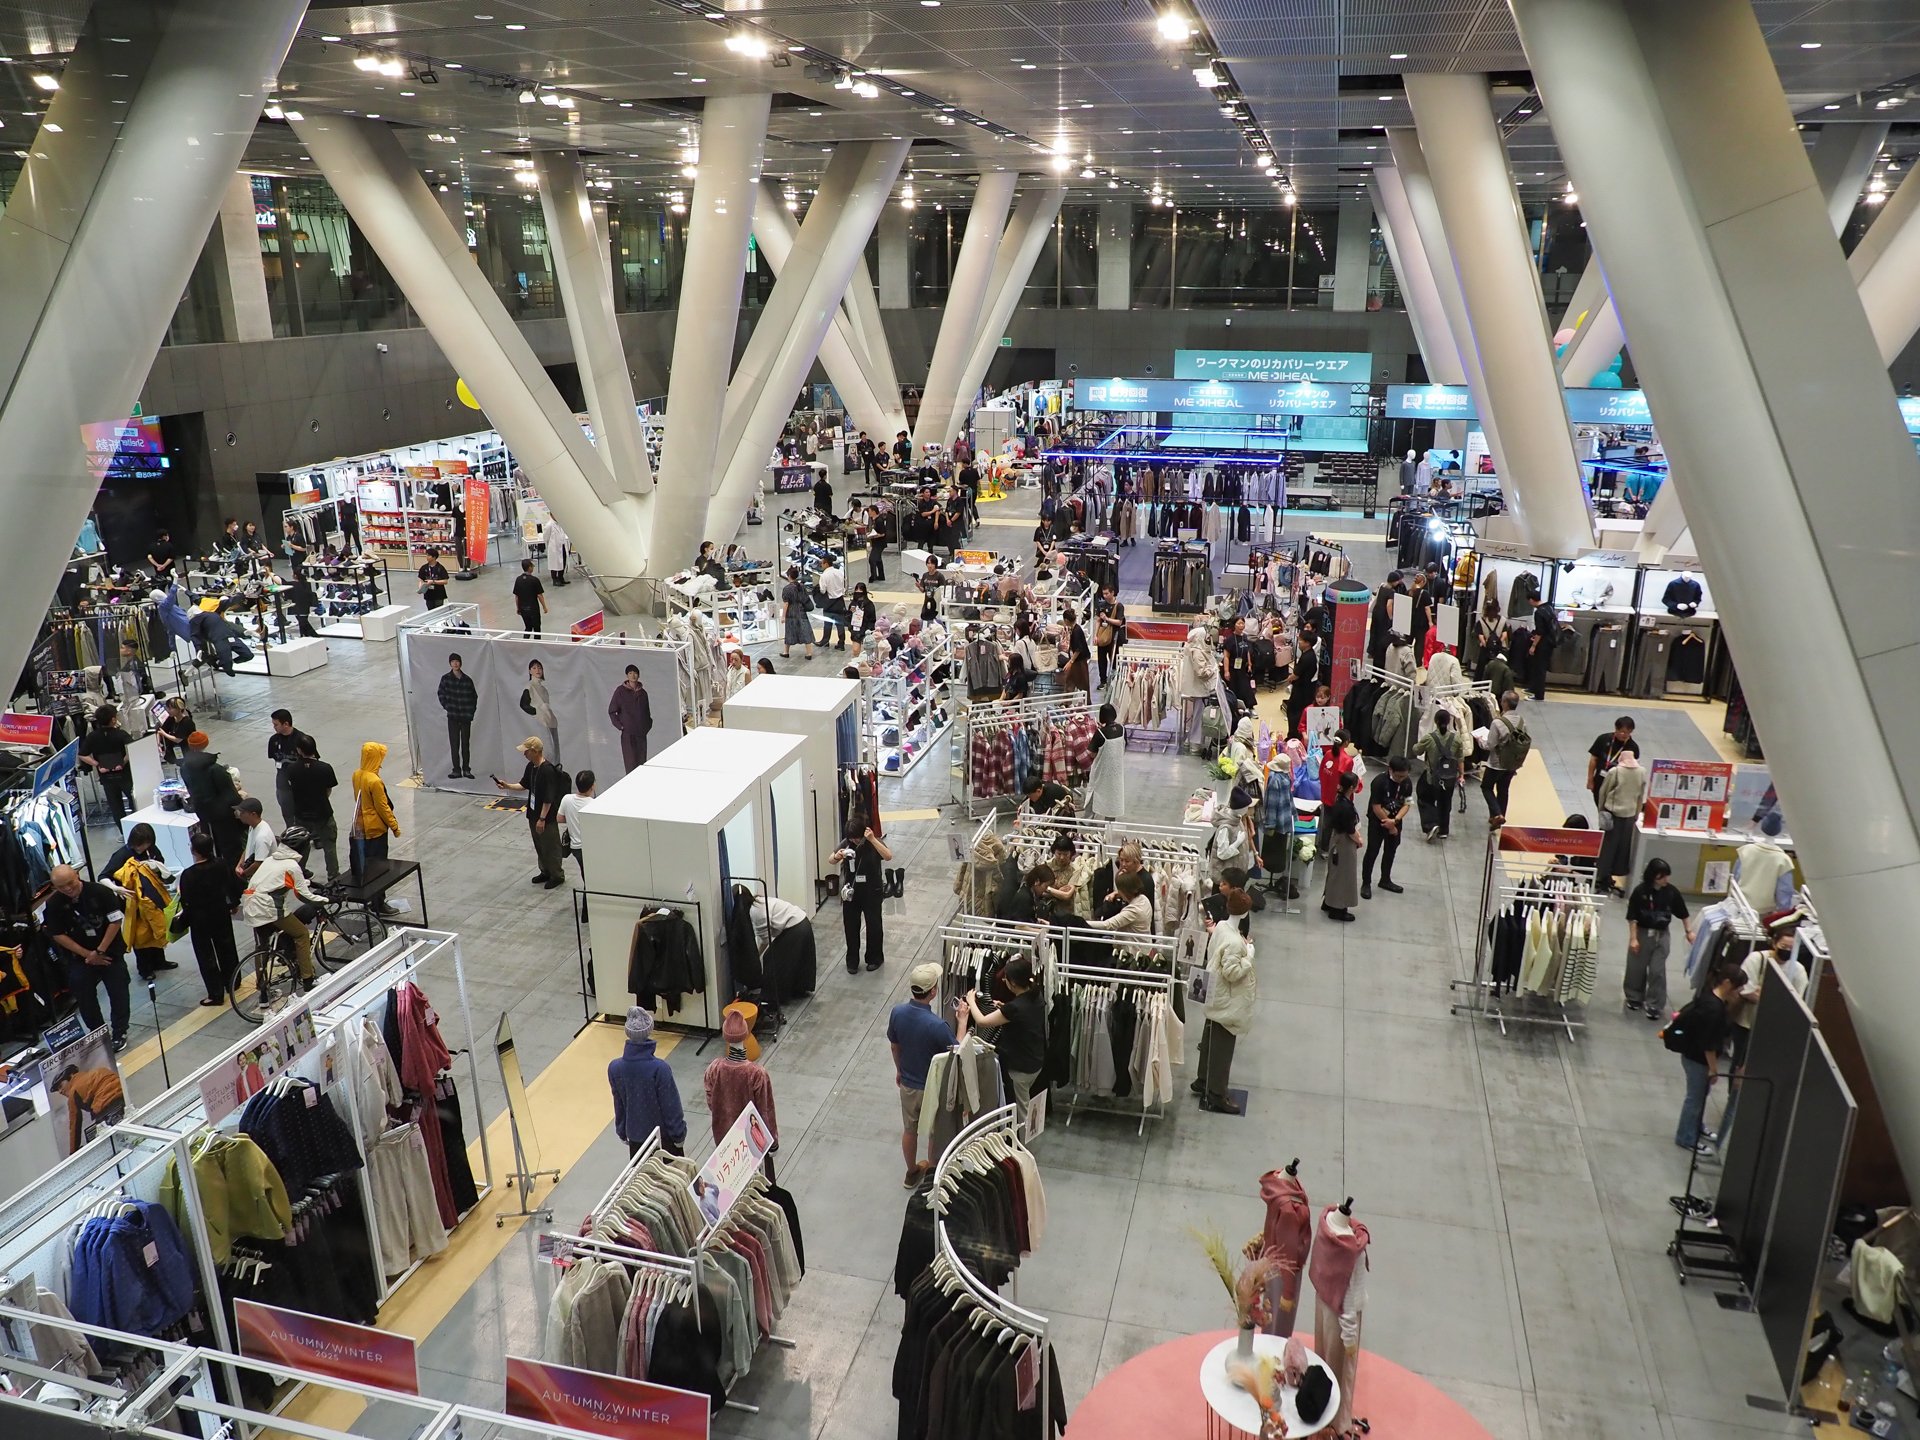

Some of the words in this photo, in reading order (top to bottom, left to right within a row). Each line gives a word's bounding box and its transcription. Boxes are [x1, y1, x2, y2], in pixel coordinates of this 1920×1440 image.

[1196, 357, 1349, 371] ワークマンのリカバリーウエア
[1277, 389, 1330, 399] ワークマンの
[1269, 399, 1337, 409] リカバリーウエア
[1519, 836, 1583, 844] AUTUMN/WINTER
[42, 1041, 85, 1070] CIRCULATOR
[85, 1026, 108, 1045] SERIES
[206, 1090, 235, 1112] WINTER
[207, 1081, 236, 1104] AUTUMN
[716, 1139, 748, 1183] リラックス
[270, 1329, 384, 1363] AUTUMN/WINTER
[314, 1349, 340, 1362] 2025
[541, 1390, 671, 1425] AUTUMN/WINTER
[591, 1411, 619, 1424] 2025
